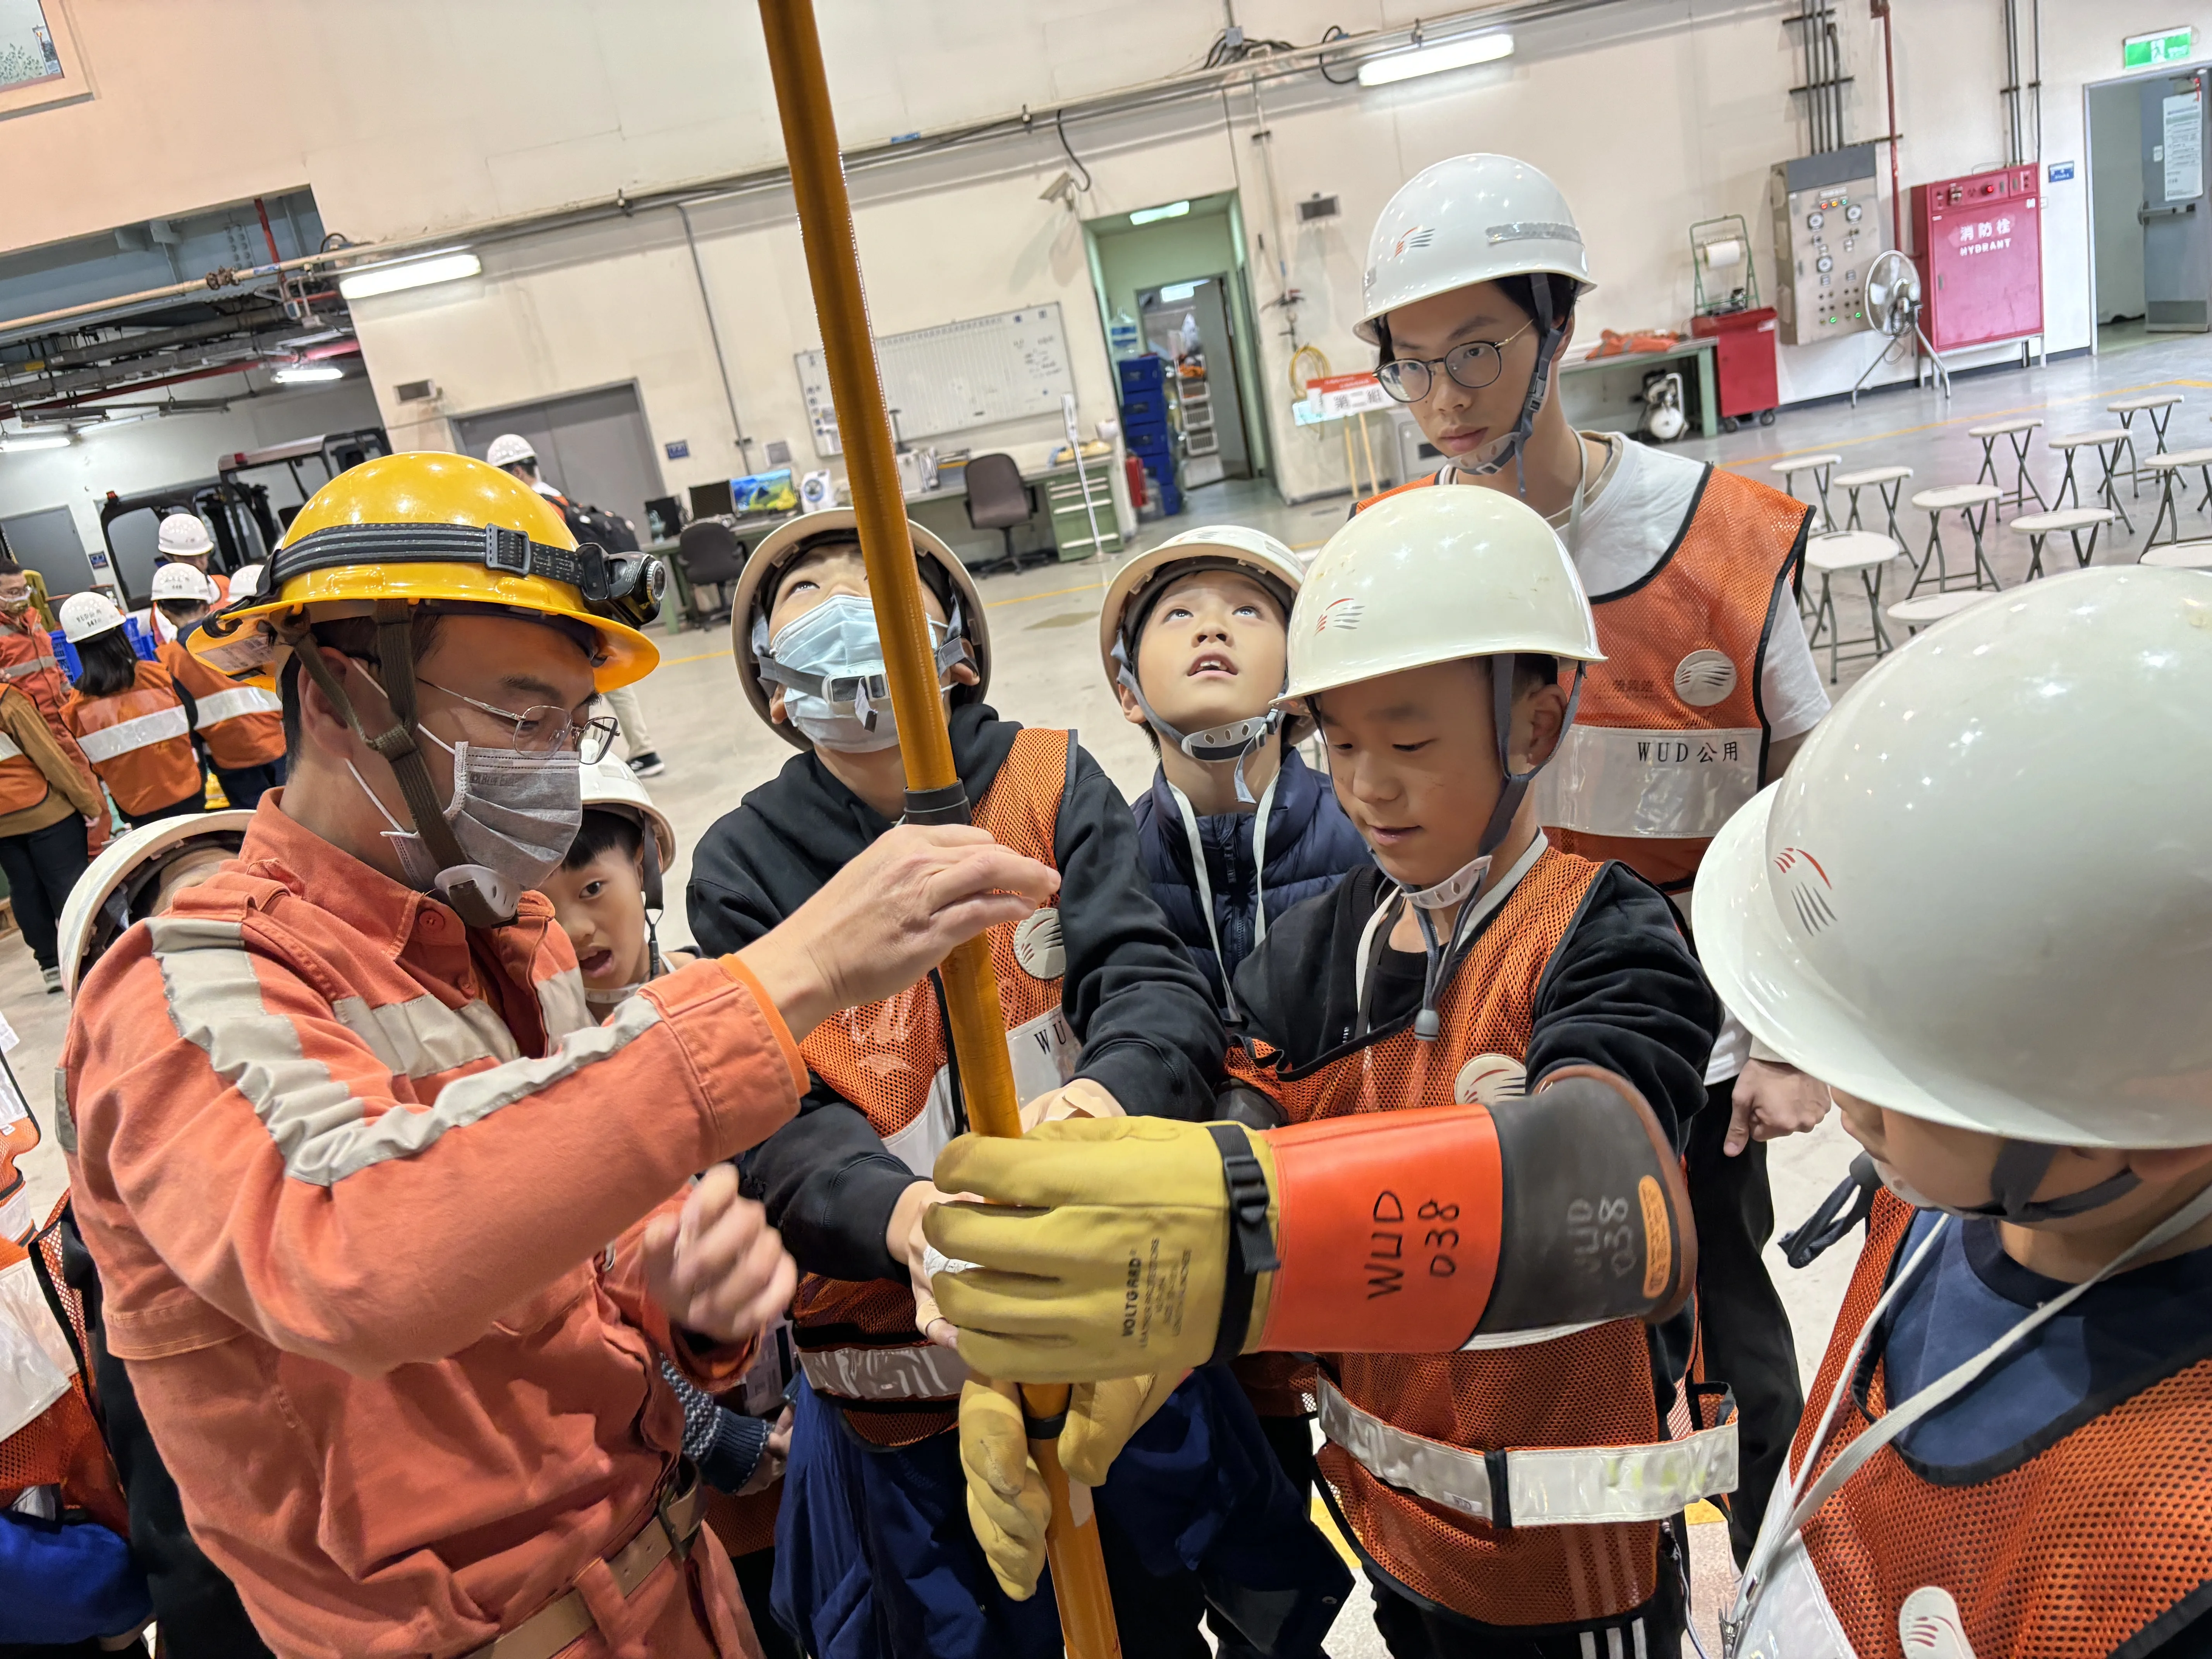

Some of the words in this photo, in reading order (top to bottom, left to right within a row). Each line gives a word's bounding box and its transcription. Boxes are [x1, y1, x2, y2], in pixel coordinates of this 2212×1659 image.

[1960, 218, 2011, 241] 消防栓
[1960, 238, 2011, 256] HYDRANT
[1034, 1020, 1066, 1055] WU
[1364, 1190, 1404, 1300] WUD
[1418, 1197, 1460, 1277] 038
[1598, 1196, 1636, 1277] 038
